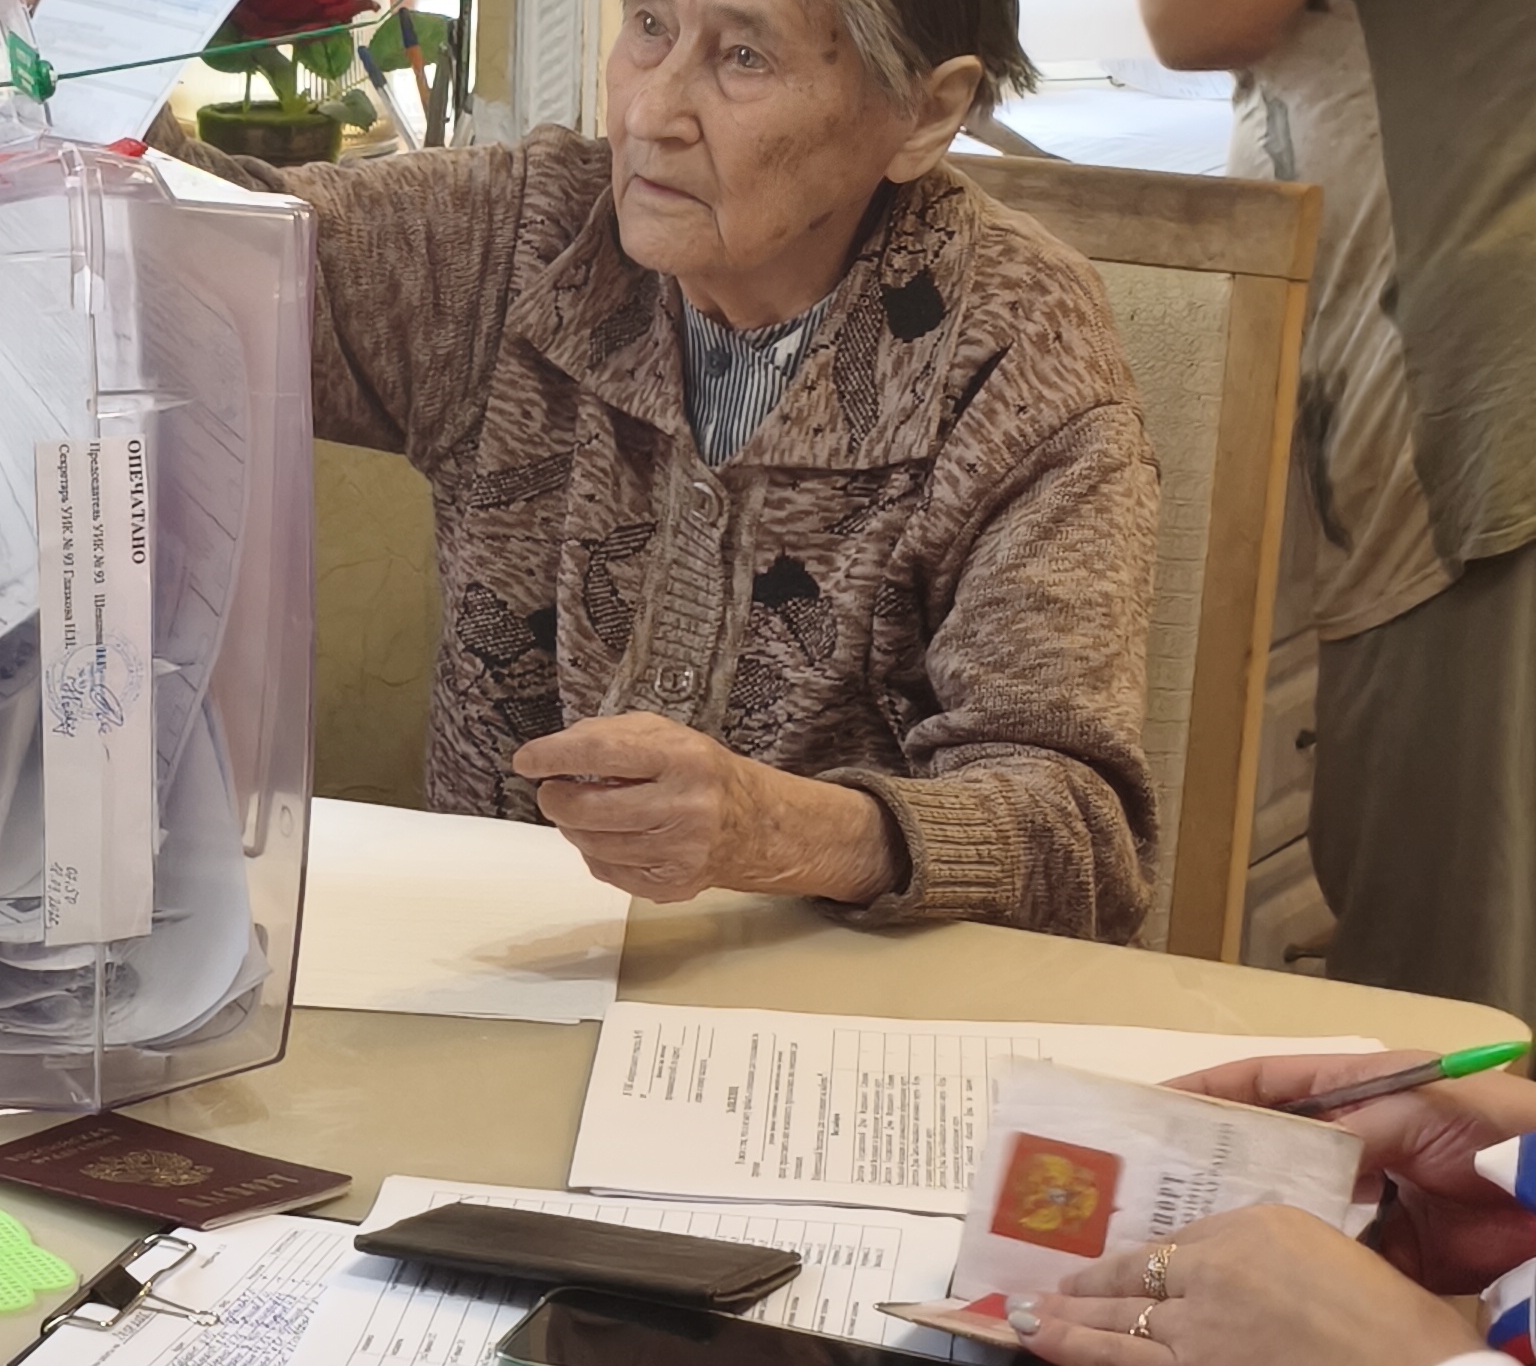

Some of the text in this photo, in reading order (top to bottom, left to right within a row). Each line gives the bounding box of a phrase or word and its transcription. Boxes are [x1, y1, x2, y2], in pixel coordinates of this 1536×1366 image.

[57, 444, 71, 504] Секретарь
[87, 443, 103, 521] Председатель
[127, 440, 145, 564] ОПЕЧАТАНО
[60, 507, 73, 534] УИК
[92, 524, 104, 552] УИК
